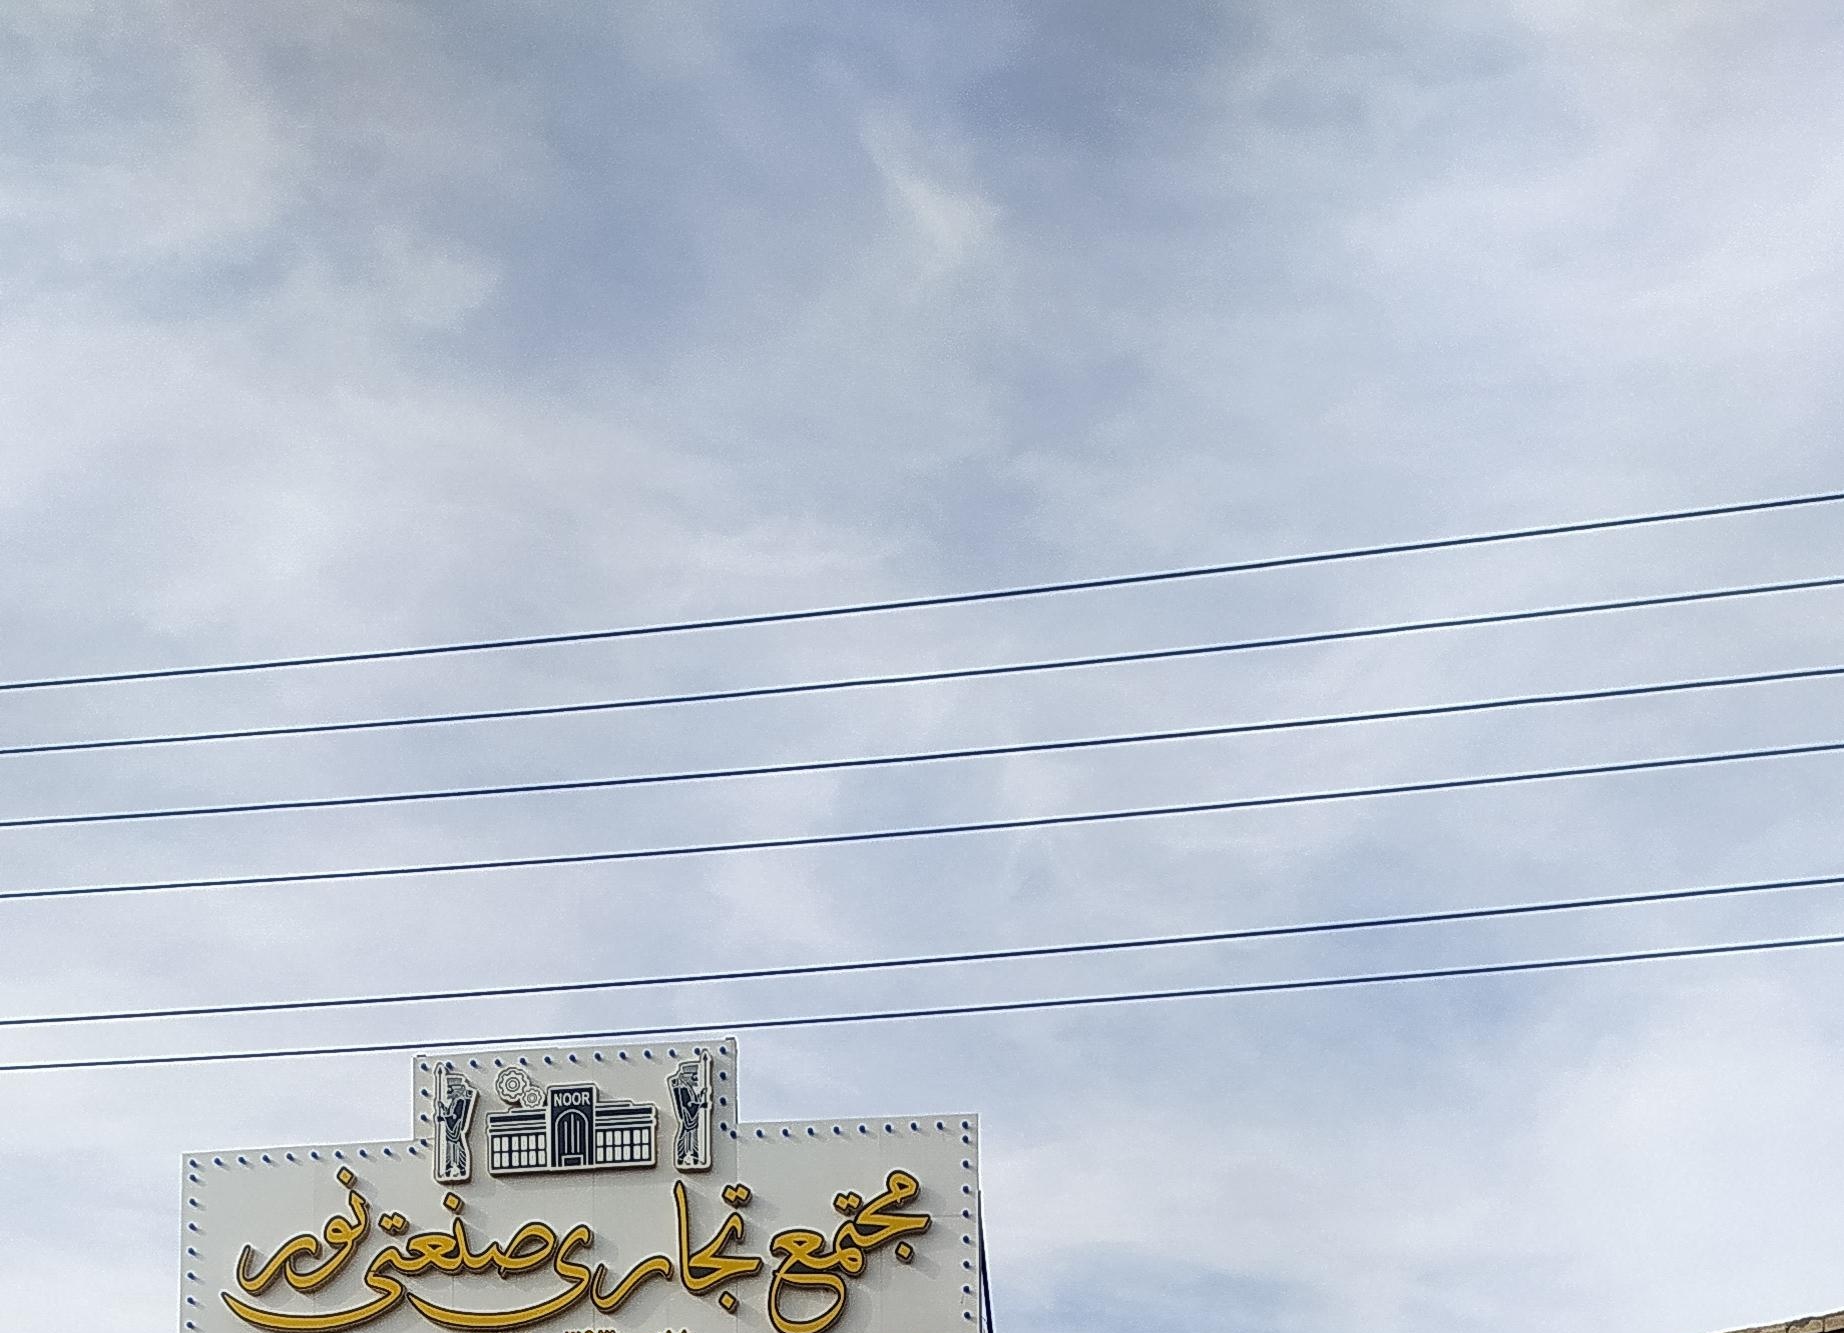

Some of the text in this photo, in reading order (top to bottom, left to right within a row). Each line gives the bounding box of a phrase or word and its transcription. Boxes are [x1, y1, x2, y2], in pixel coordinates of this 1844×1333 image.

[553, 1090, 592, 1107] NOOR
[220, 1192, 558, 1333] صنعتی
[235, 1166, 369, 1295] نور
[405, 1179, 764, 1329] تجاری
